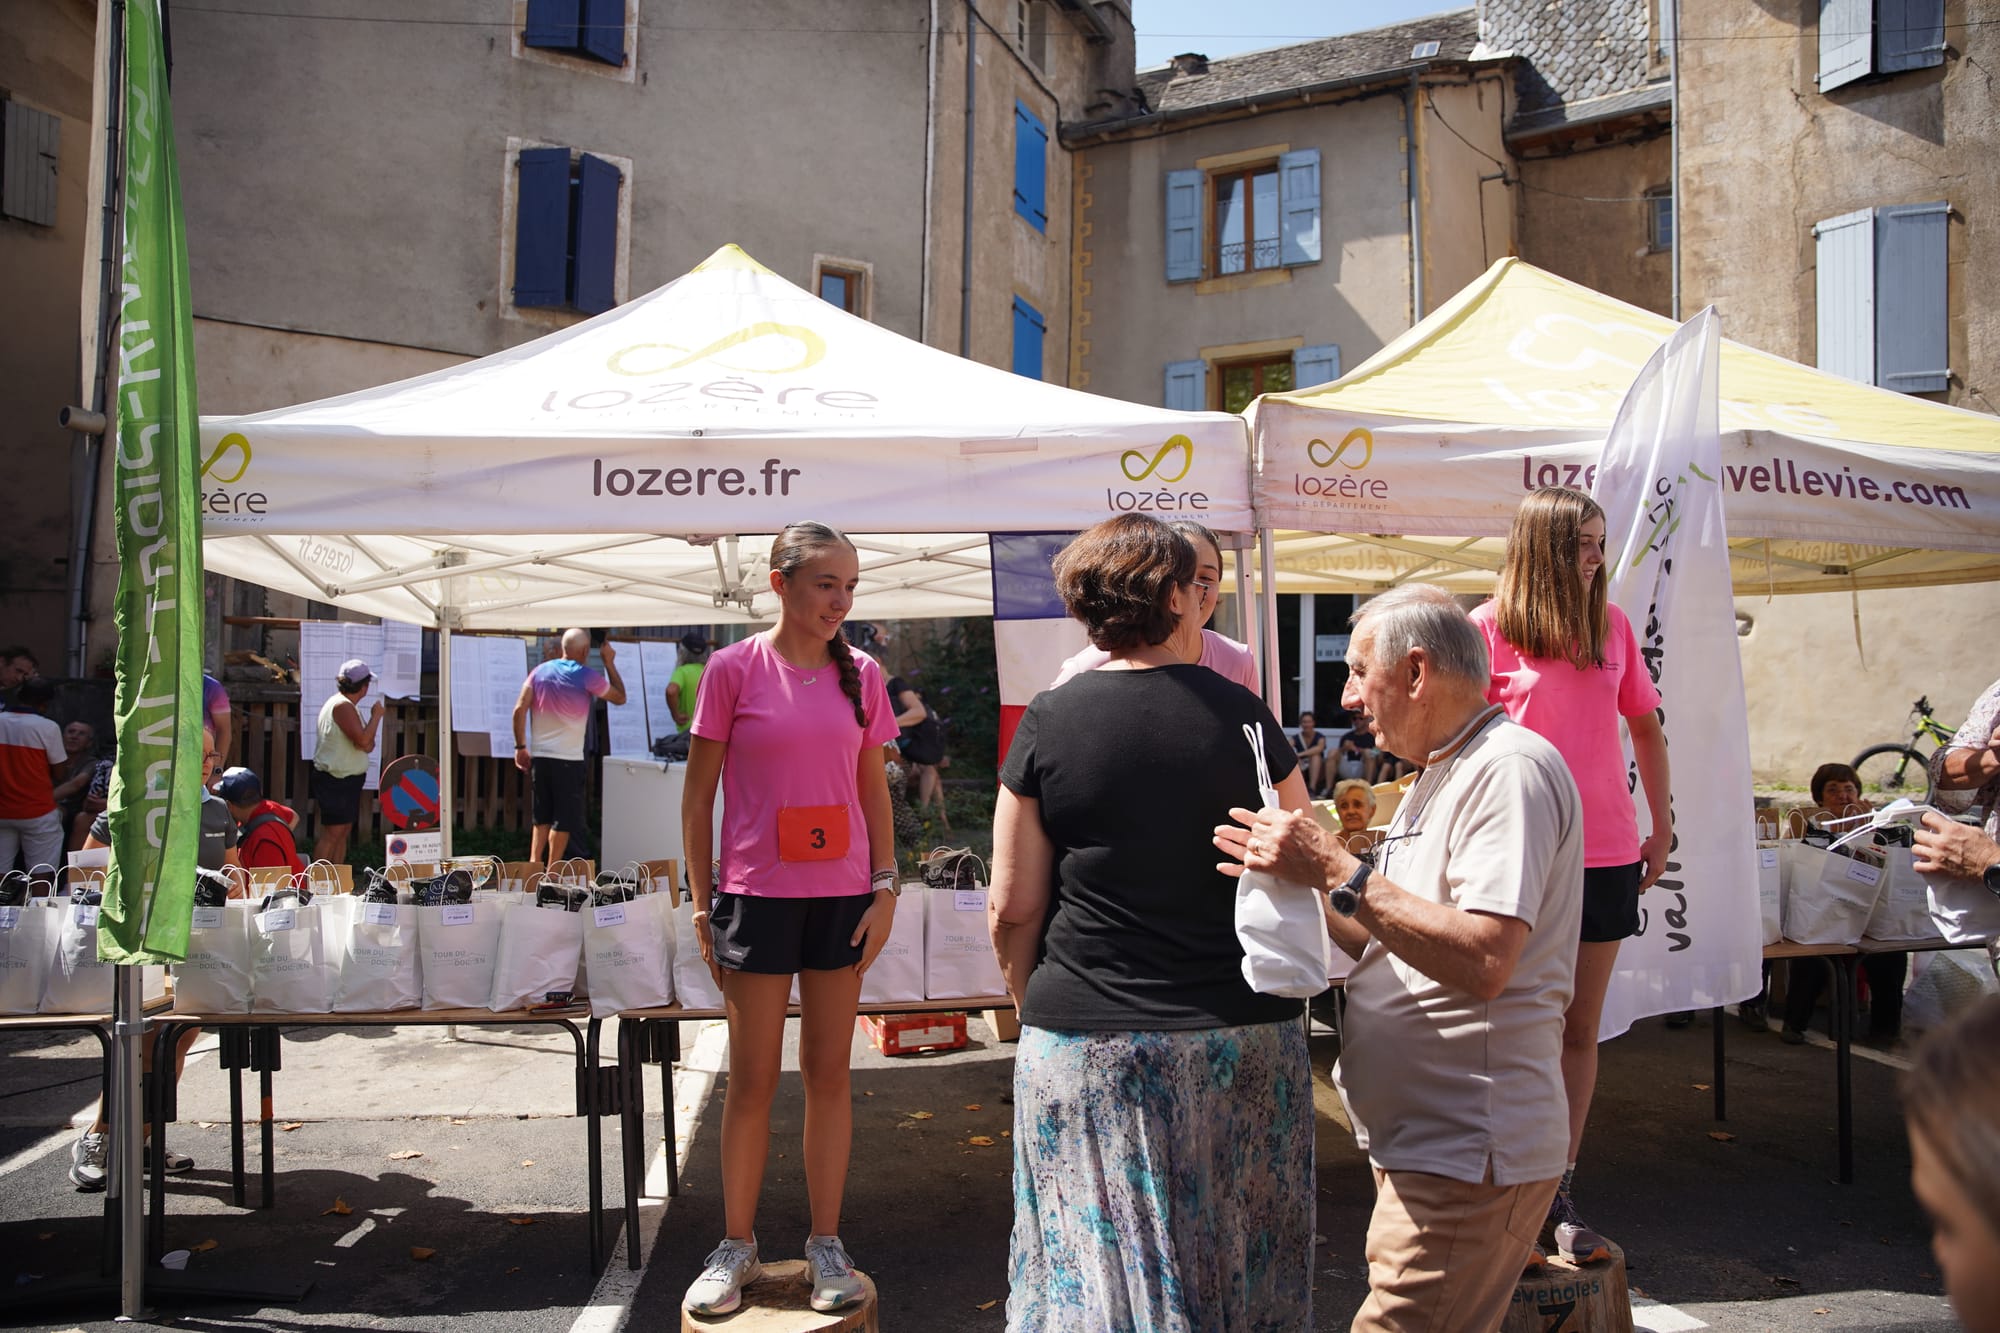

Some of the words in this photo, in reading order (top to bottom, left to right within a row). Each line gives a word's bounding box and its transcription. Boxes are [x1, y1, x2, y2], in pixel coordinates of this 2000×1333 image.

[593, 458, 801, 496] lozere.fr
[1295, 473, 1388, 499] lozère
[1107, 487, 1209, 511] lozère
[810, 827, 826, 849] 3
[1511, 1280, 1600, 1303] evenoles
